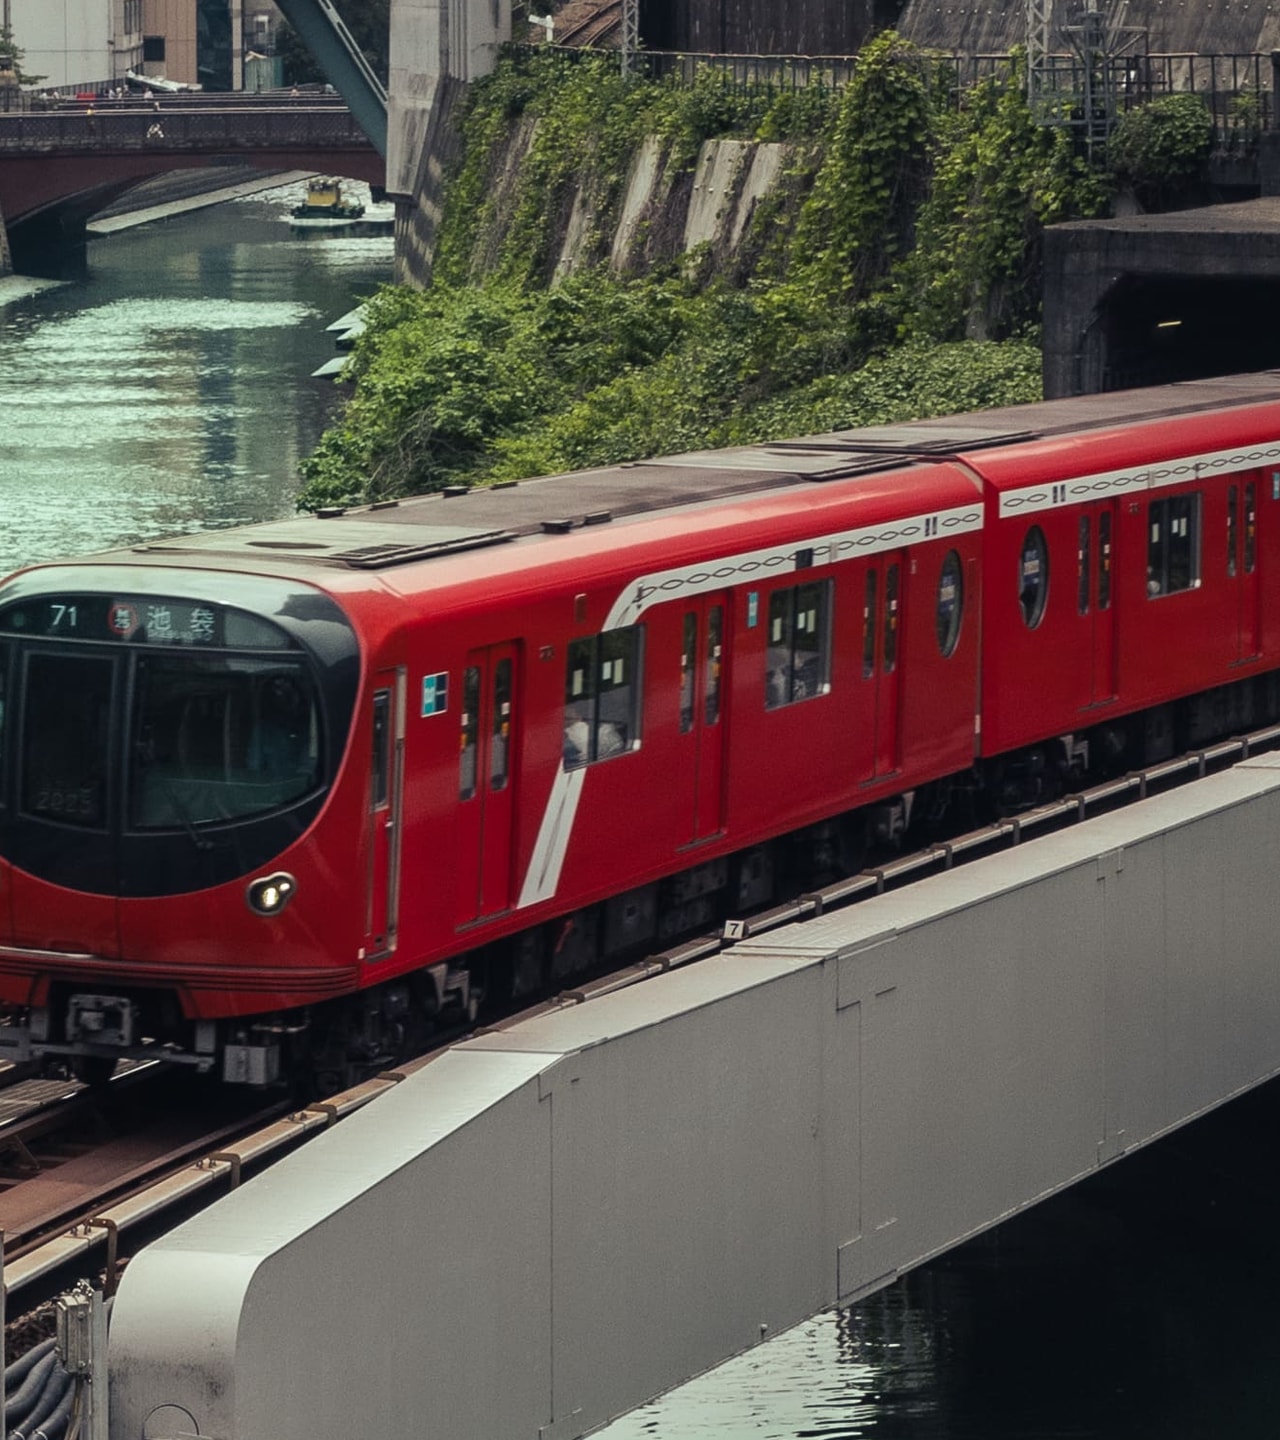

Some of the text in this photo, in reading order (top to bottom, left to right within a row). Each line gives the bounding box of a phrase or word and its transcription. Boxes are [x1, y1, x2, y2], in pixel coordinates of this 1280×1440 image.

[51, 605, 77, 627] 71
[147, 605, 215, 635] 池袋
[730, 923, 740, 936] 7
